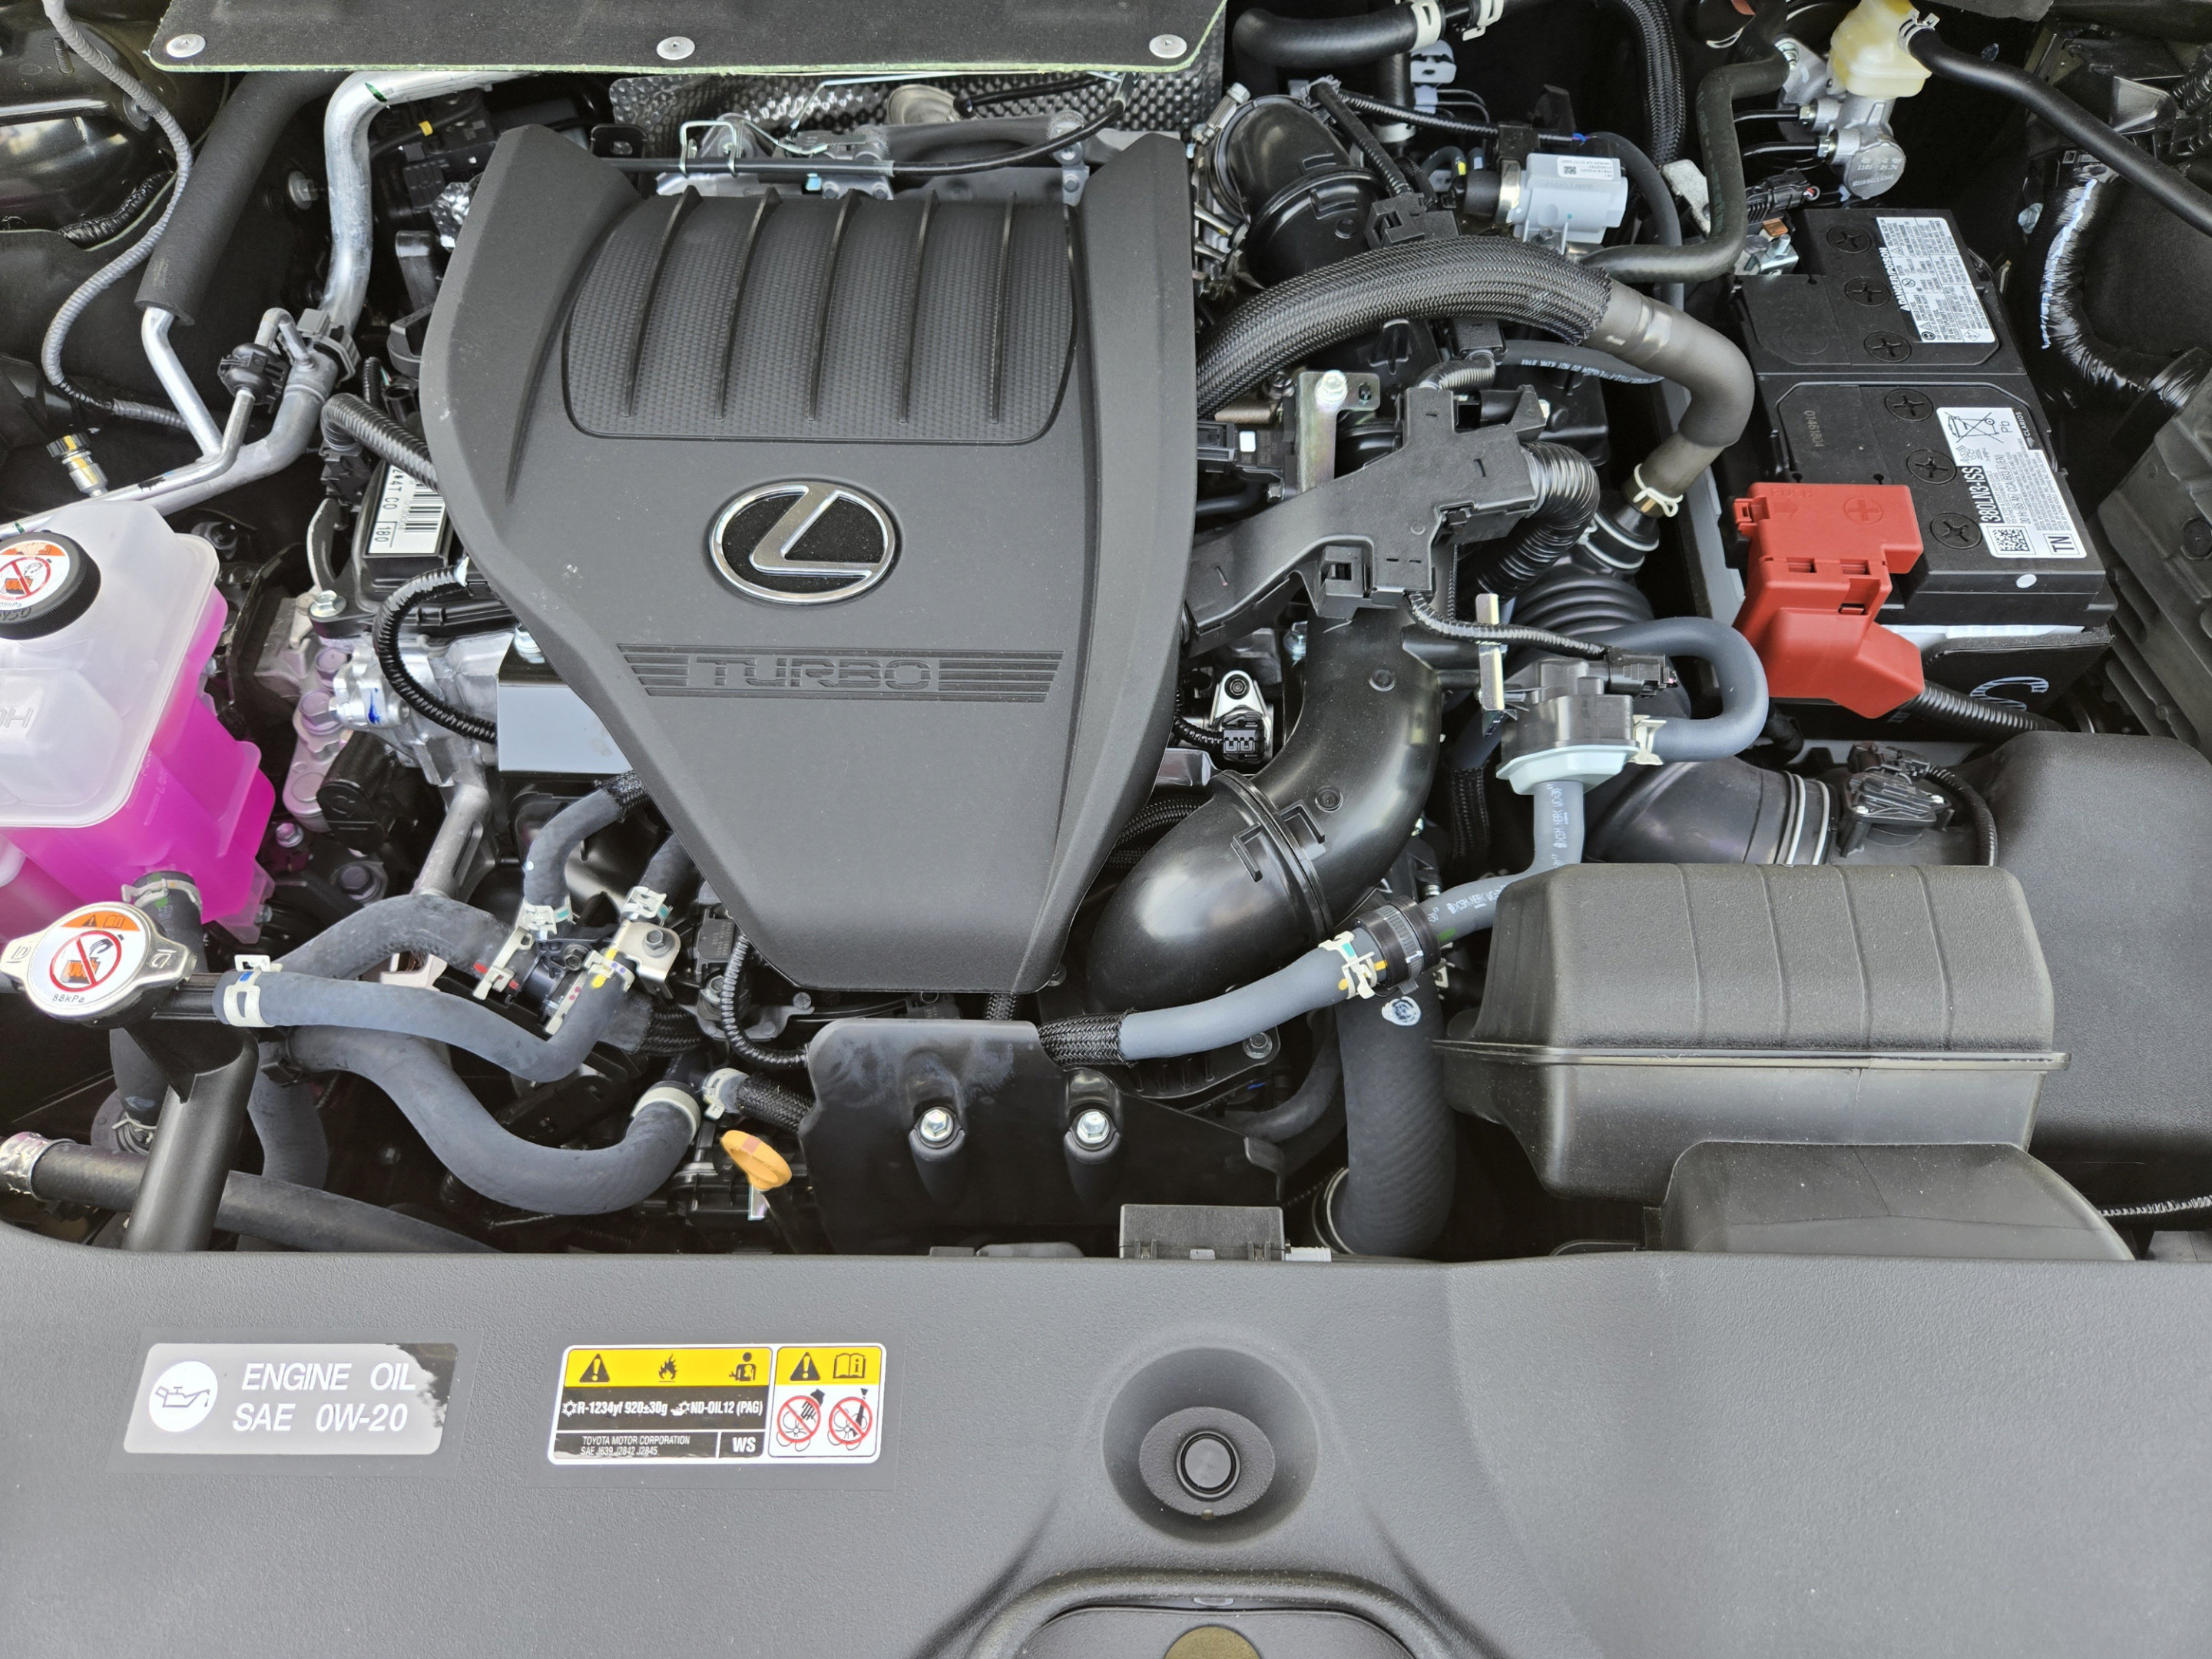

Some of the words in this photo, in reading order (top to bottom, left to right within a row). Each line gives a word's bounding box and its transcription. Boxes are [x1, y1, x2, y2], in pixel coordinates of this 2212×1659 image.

[1878, 247, 1907, 304] DANGER/POISON
[1998, 420, 2013, 432] Pb
[2015, 411, 2031, 435] CLARIOS
[1960, 467, 2002, 521] 380LN3-ISS
[374, 526, 392, 542] 180
[2047, 535, 2076, 552] TN
[697, 656, 932, 690] TURBO
[51, 995, 85, 1003] 88kPa
[241, 1363, 352, 1391] ENGINE
[370, 1363, 417, 1391] OIL
[577, 1401, 624, 1417] R-1234yf
[624, 1401, 668, 1416] 920±30g
[690, 1401, 735, 1415] ND-OIL12
[737, 1400, 763, 1416] (PAG)
[233, 1403, 296, 1432] SAE
[315, 1403, 409, 1432] 0W-20
[582, 1435, 611, 1445] TOYOTA
[611, 1435, 638, 1445] MOTOR
[639, 1435, 690, 1445] CORPORATION
[732, 1437, 757, 1453] WS
[581, 1446, 595, 1456] SAE
